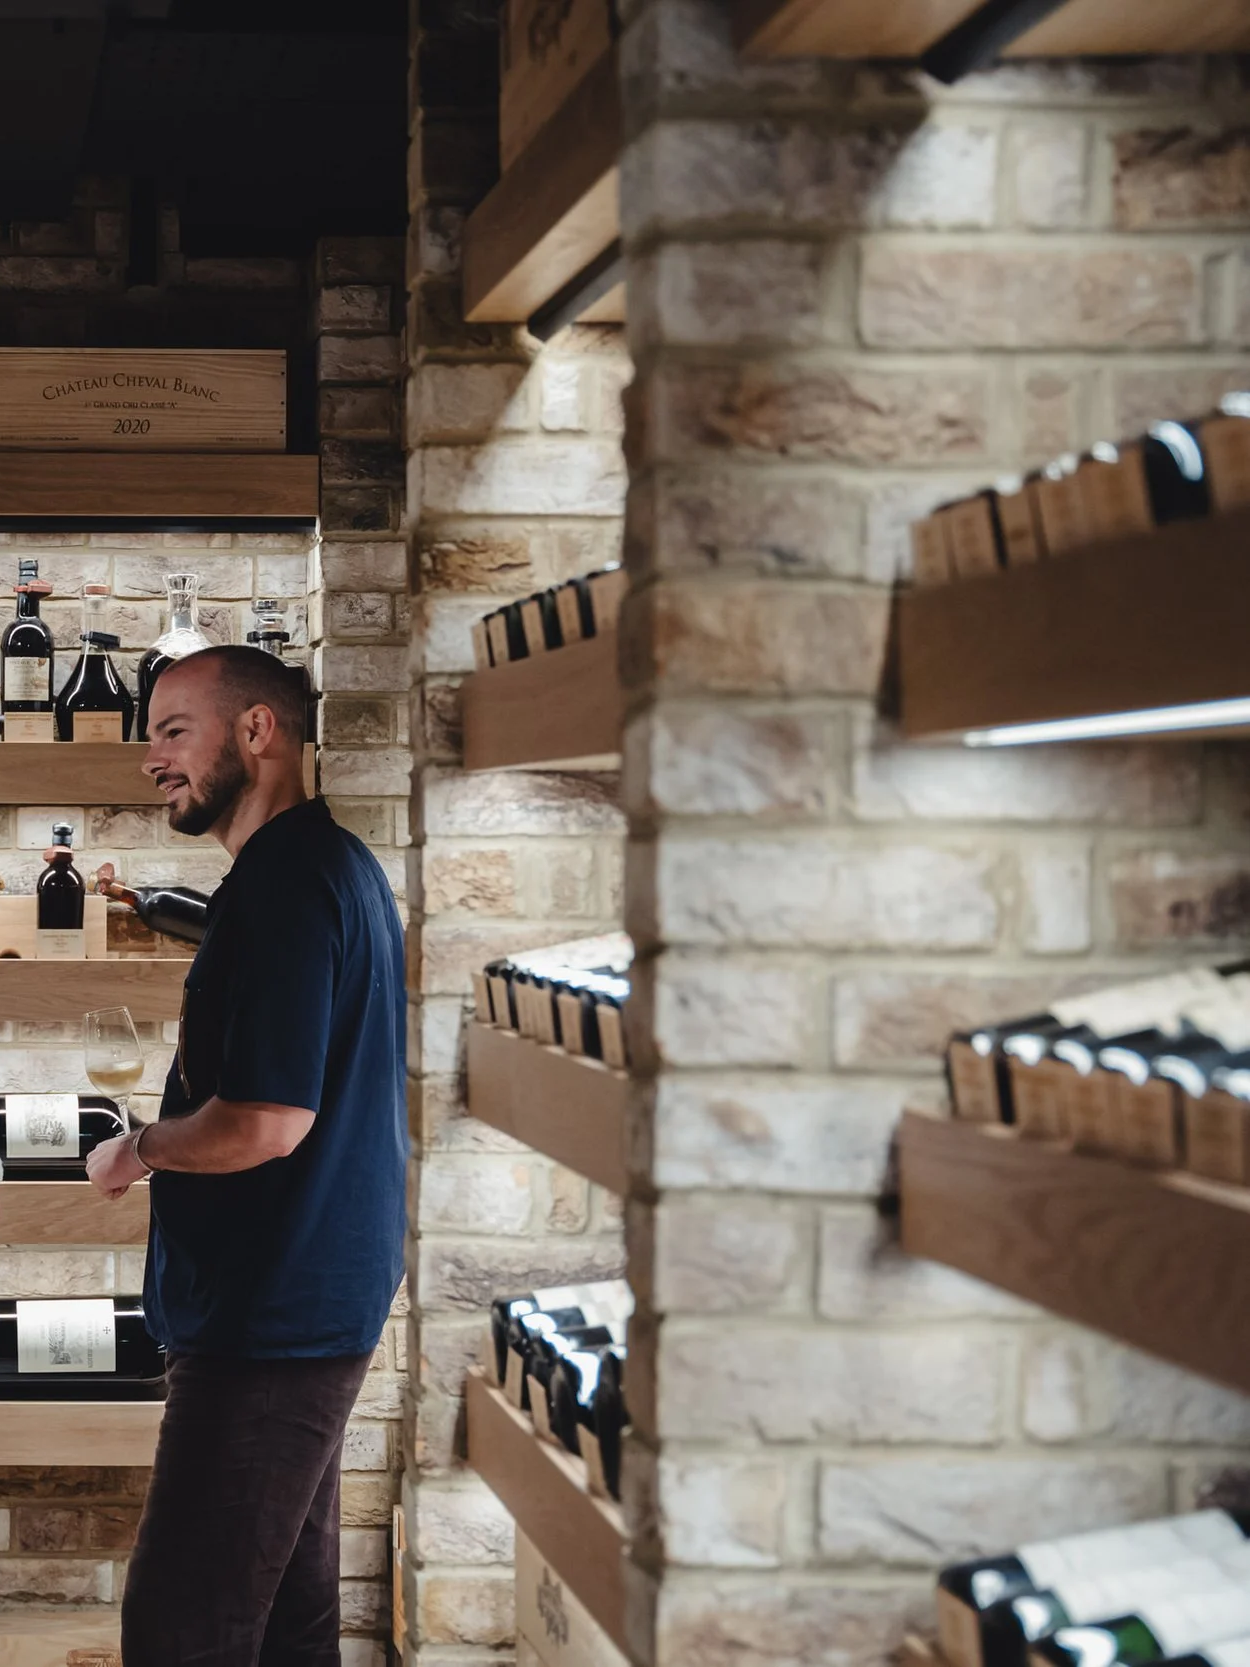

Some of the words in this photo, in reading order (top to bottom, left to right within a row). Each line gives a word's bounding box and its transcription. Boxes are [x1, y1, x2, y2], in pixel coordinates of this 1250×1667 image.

[42, 377, 109, 401] CHÂTEAU
[113, 372, 168, 390] CHEVAL
[173, 377, 221, 403] BLANC
[113, 418, 151, 434] 2020
